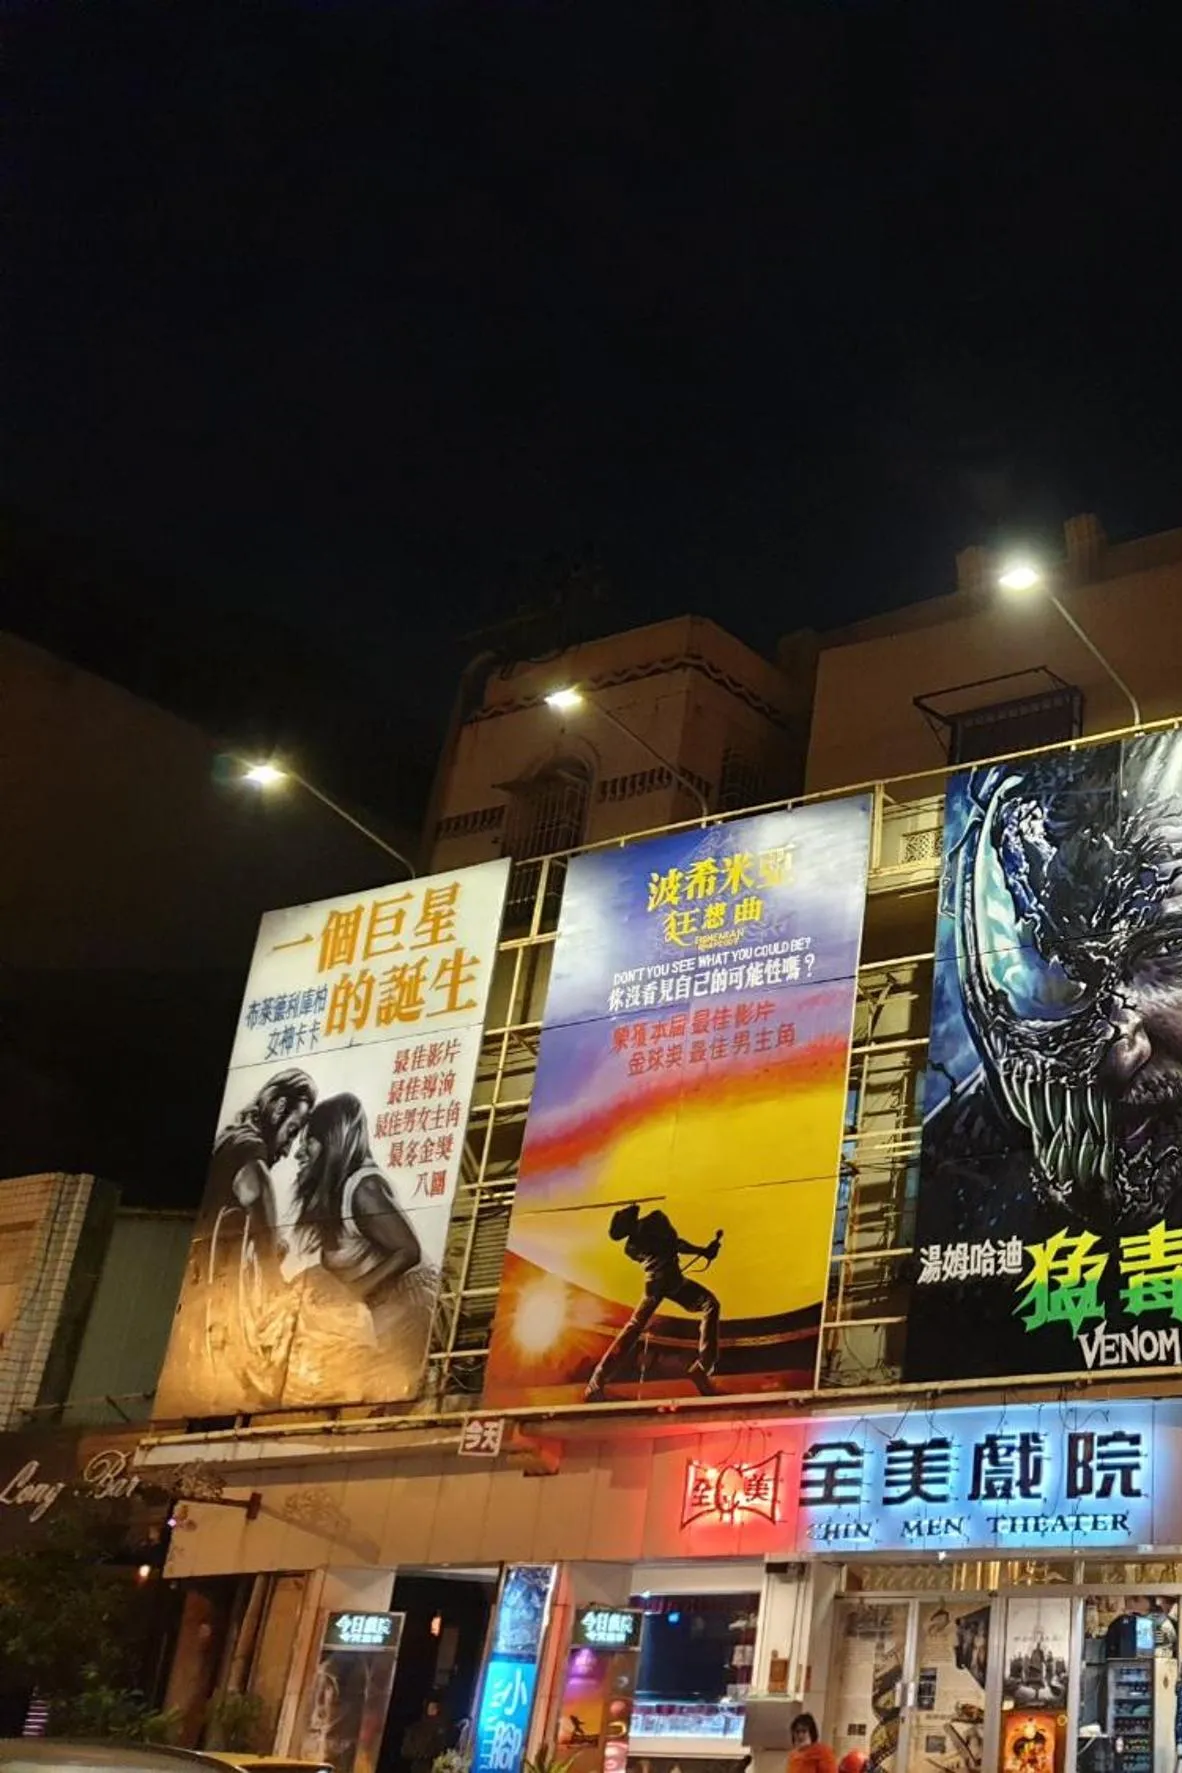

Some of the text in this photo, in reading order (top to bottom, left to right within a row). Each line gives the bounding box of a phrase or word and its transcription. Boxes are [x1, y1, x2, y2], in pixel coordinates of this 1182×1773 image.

[271, 881, 461, 974] 一個巨星
[664, 896, 764, 947] 狂想曲
[646, 962, 670, 978] YOU
[672, 957, 696, 974] SEE
[698, 950, 733, 967] WHAT
[732, 947, 752, 962] YOU
[754, 942, 790, 957] COULD
[323, 947, 482, 1037] 的誕生
[264, 1019, 321, 1061] 女神卡卡
[393, 1038, 461, 1074] 最佳影片
[387, 1069, 456, 1105] 最佳導演
[374, 1100, 461, 1139] 最佳男女主角
[917, 1235, 1023, 1286] 湯姆哈迪
[1077, 1319, 1182, 1370] VENOM
[800, 1432, 1144, 1508] 全美戲院
[899, 1516, 966, 1537] MEN
[987, 1512, 1131, 1535] THEATER
